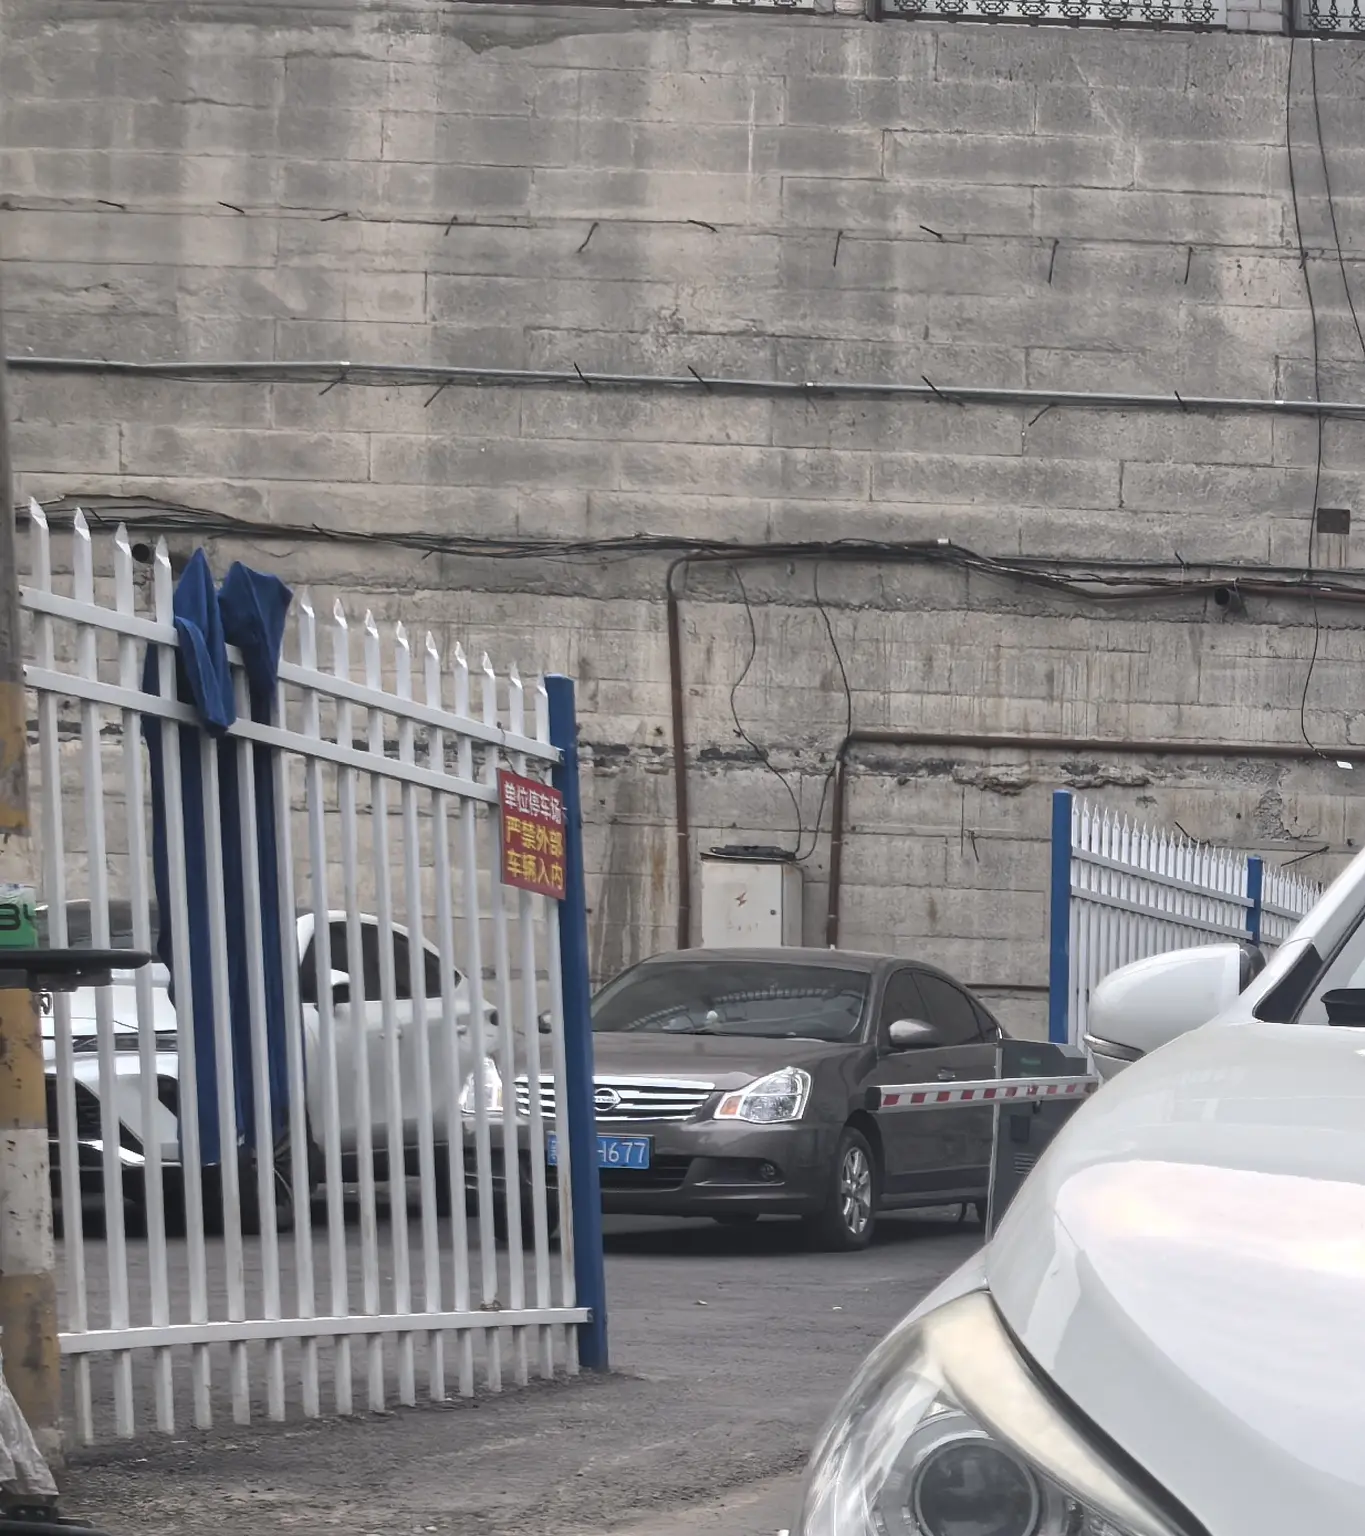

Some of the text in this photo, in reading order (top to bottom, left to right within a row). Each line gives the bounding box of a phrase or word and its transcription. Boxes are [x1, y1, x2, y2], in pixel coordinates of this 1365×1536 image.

[504, 780, 562, 825] 单位停车场
[505, 815, 564, 858] 严禁外部
[506, 848, 564, 890] 车辆入内
